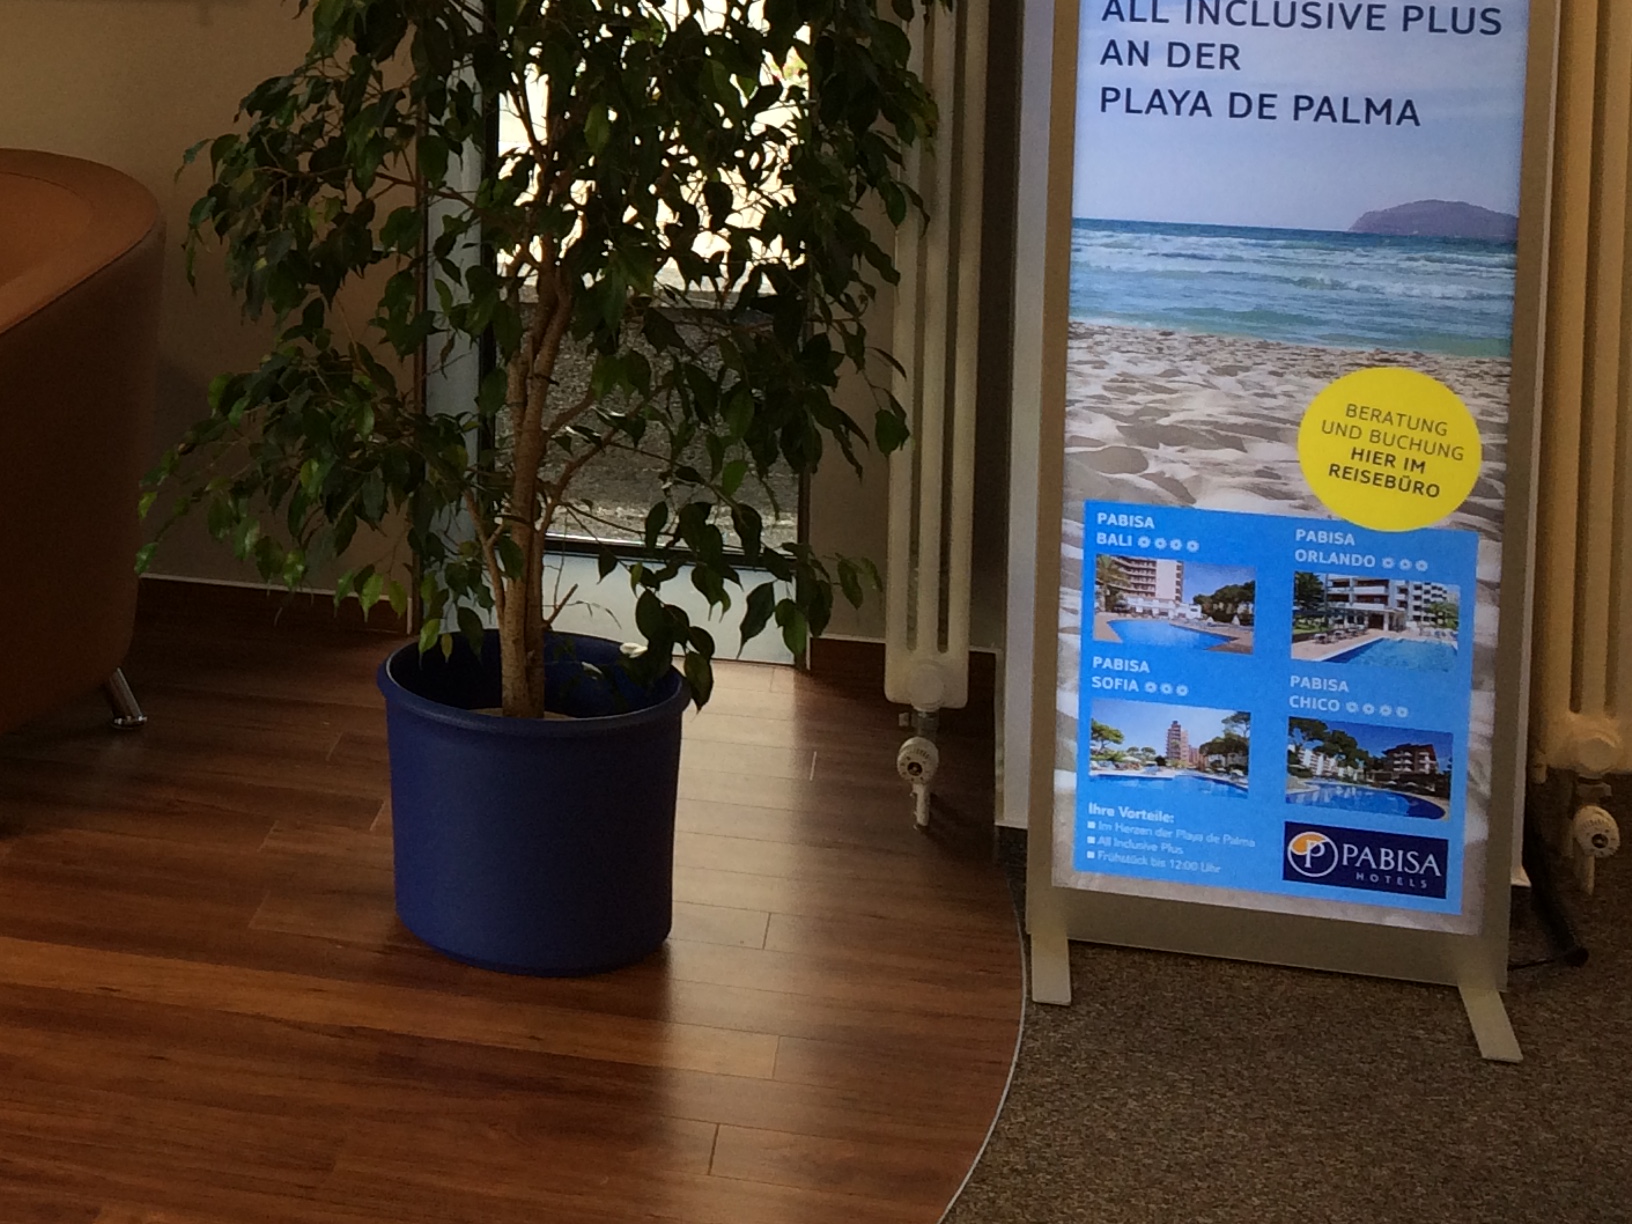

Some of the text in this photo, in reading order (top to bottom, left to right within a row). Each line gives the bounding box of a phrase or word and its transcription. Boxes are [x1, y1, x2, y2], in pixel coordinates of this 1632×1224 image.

[1401, 4, 1503, 36] PLUS
[1100, 38, 1241, 71] AN DER
[1100, 86, 1422, 127] PLAYA DE PALMA
[1345, 403, 1448, 436] BERATUNG
[1321, 419, 1465, 461] UND BUCHUNG
[1350, 447, 1426, 474] HIER IM
[1328, 463, 1440, 498] REISEBÜRO
[1096, 512, 1155, 529] PABISA
[1096, 532, 1132, 547] BALI
[1295, 528, 1355, 546] PABISA
[1294, 549, 1376, 568] ORLANDO
[1092, 656, 1150, 673] PABISA
[1091, 676, 1139, 692] SOFIA
[1290, 675, 1349, 693] PABISA
[1288, 695, 1340, 712] CHICO
[1088, 802, 1175, 823] Ihre Vorteile:
[1098, 821, 1256, 847] Im Herzen der Playa de Palma
[1097, 836, 1184, 855] All Inclusive Plus
[1097, 850, 1221, 873] Frühstück bis 12:00 Uhr
[1342, 843, 1442, 877] PABISA
[1355, 872, 1428, 889] HOTELS
